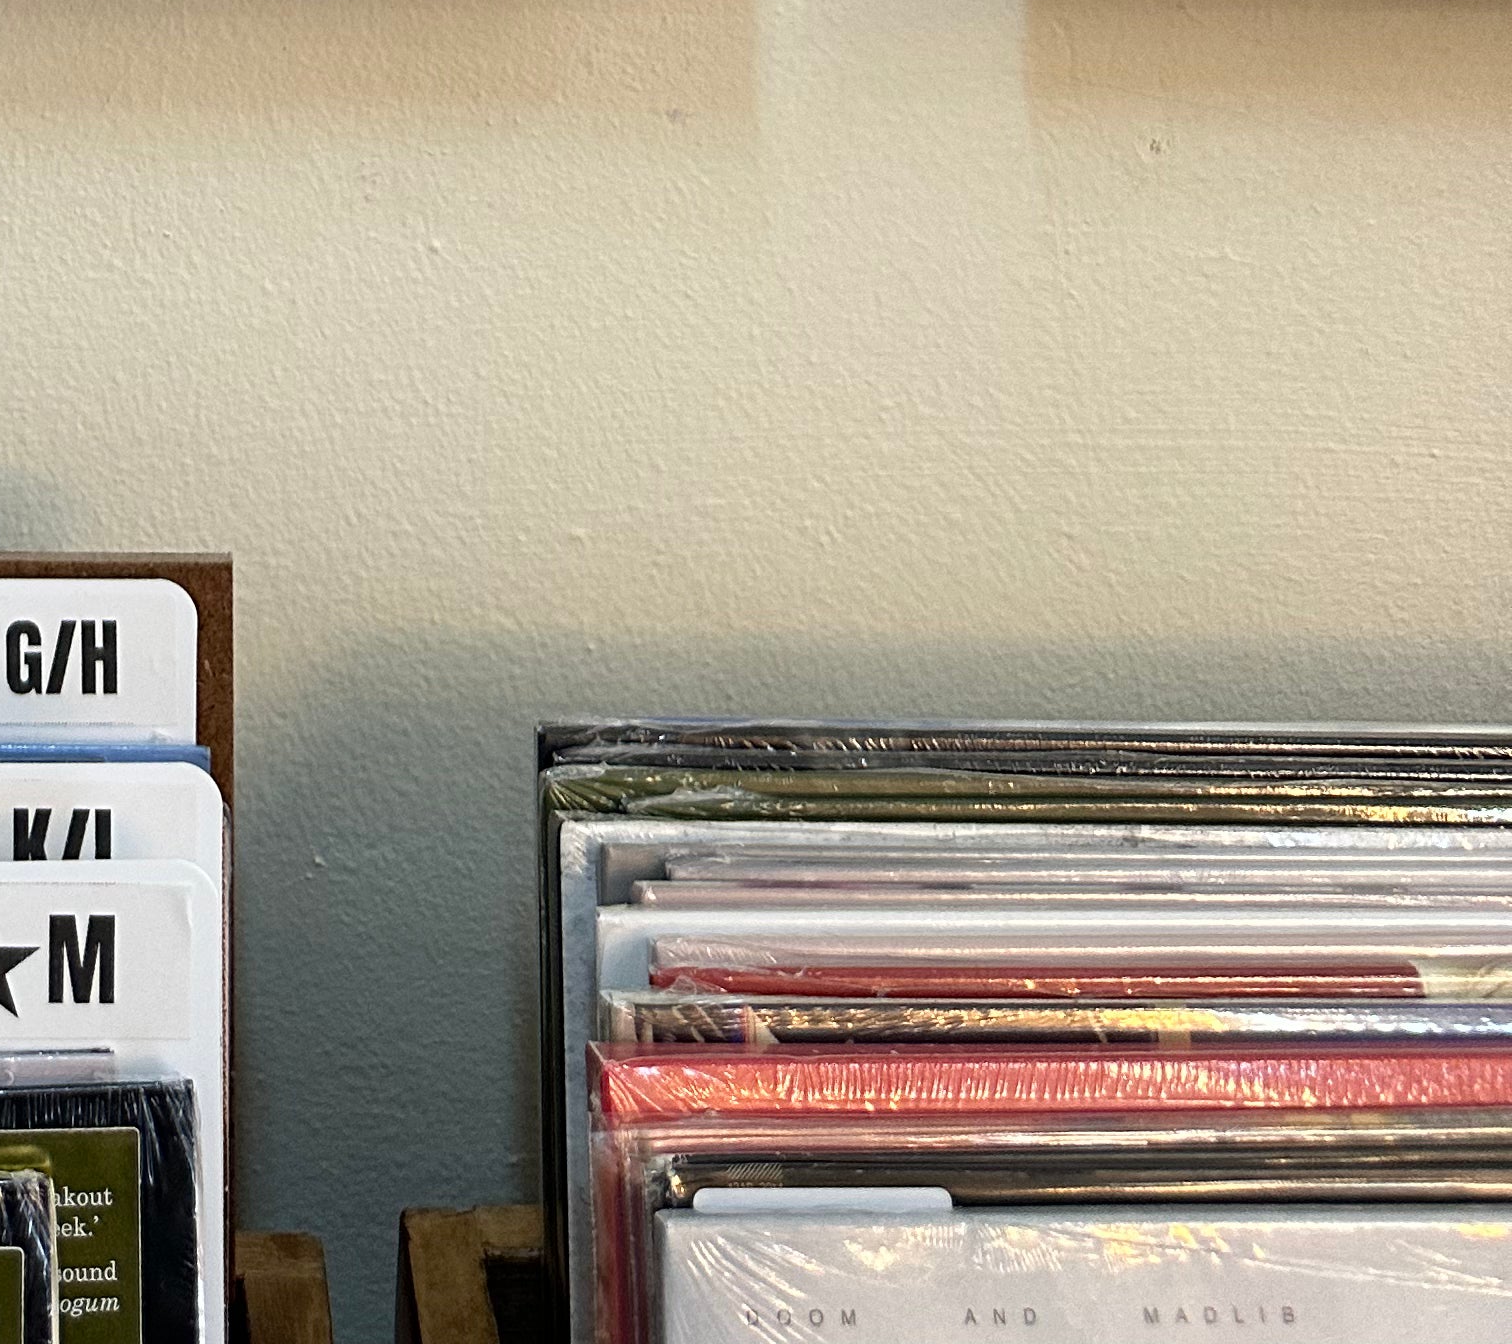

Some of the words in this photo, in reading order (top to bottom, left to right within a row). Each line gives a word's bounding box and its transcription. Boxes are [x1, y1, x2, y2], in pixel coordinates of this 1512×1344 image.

[6, 620, 117, 694] G/H
[49, 916, 114, 1003] M
[964, 1305, 1039, 1326] AND
[1142, 1305, 1297, 1325] MADLIB
